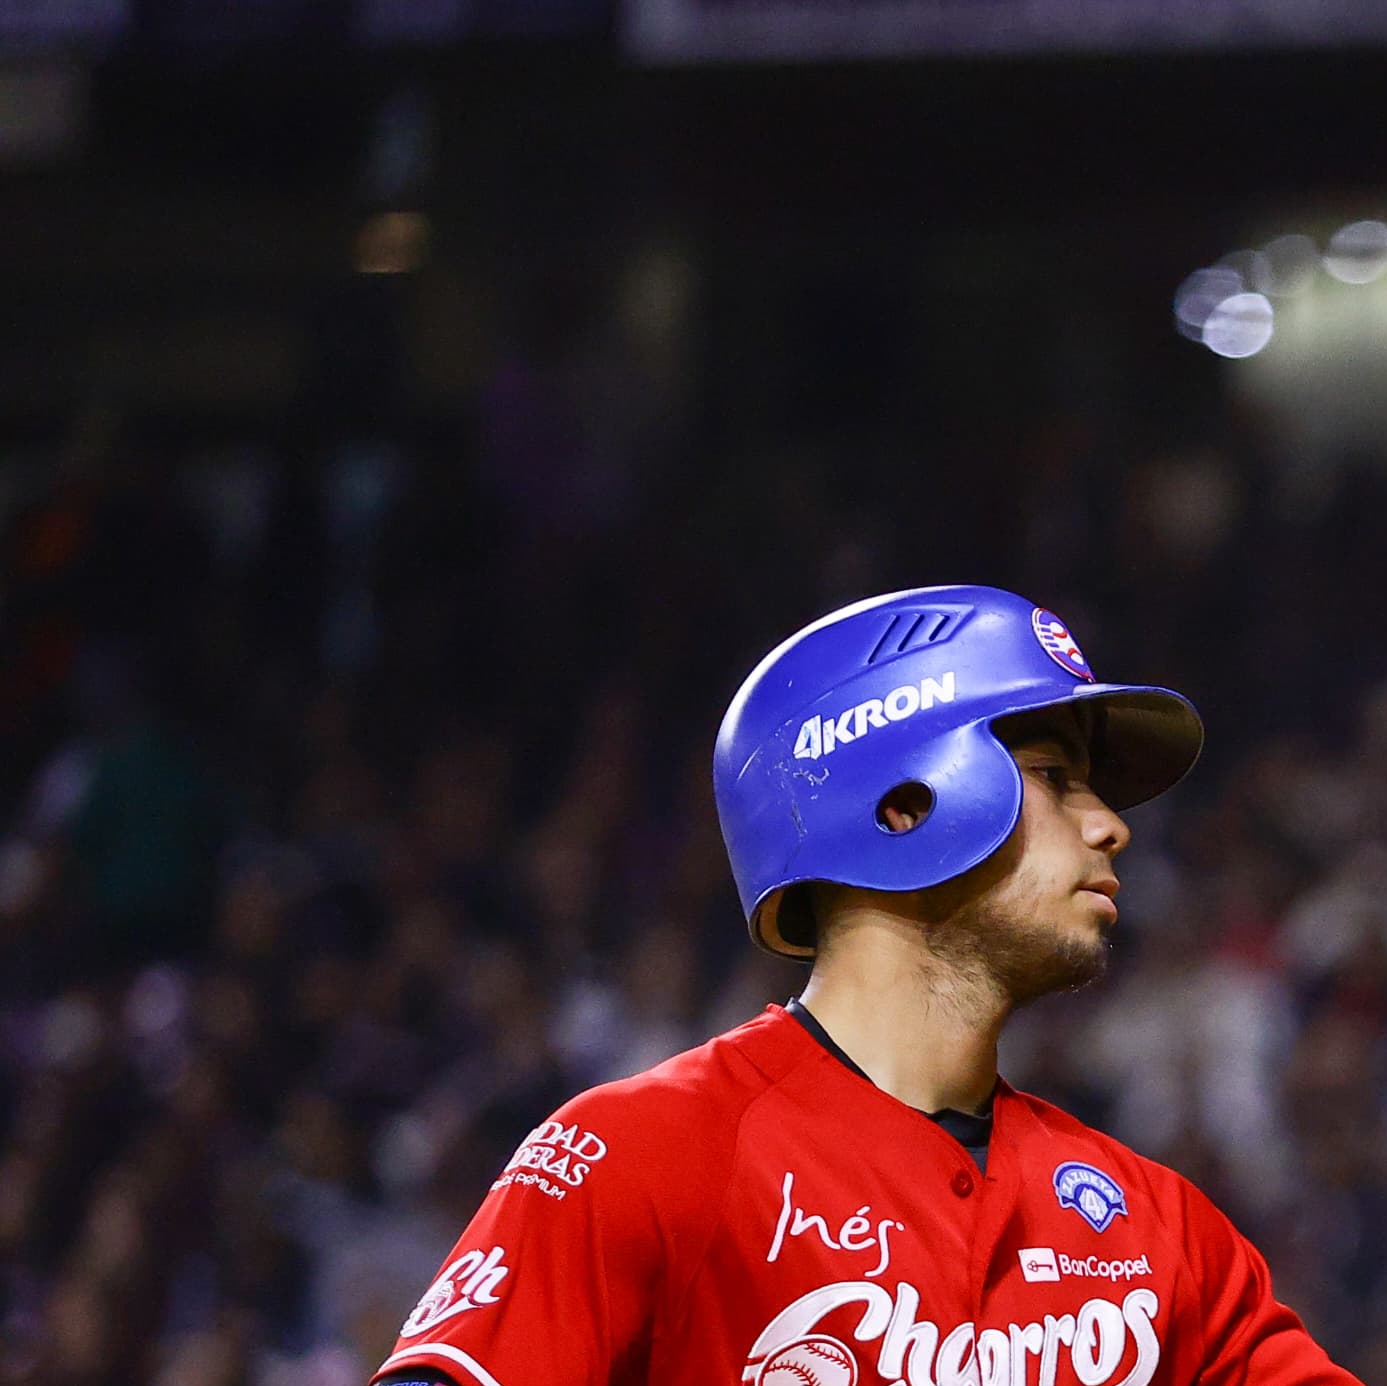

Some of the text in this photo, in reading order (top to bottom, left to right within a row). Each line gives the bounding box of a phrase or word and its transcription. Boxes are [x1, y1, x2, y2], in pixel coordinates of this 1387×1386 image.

[793, 671, 956, 761] AKRON
[766, 1171, 905, 1278] Inés
[1084, 1187, 1106, 1222] 4
[1057, 1252, 1153, 1282] BanCoppel
